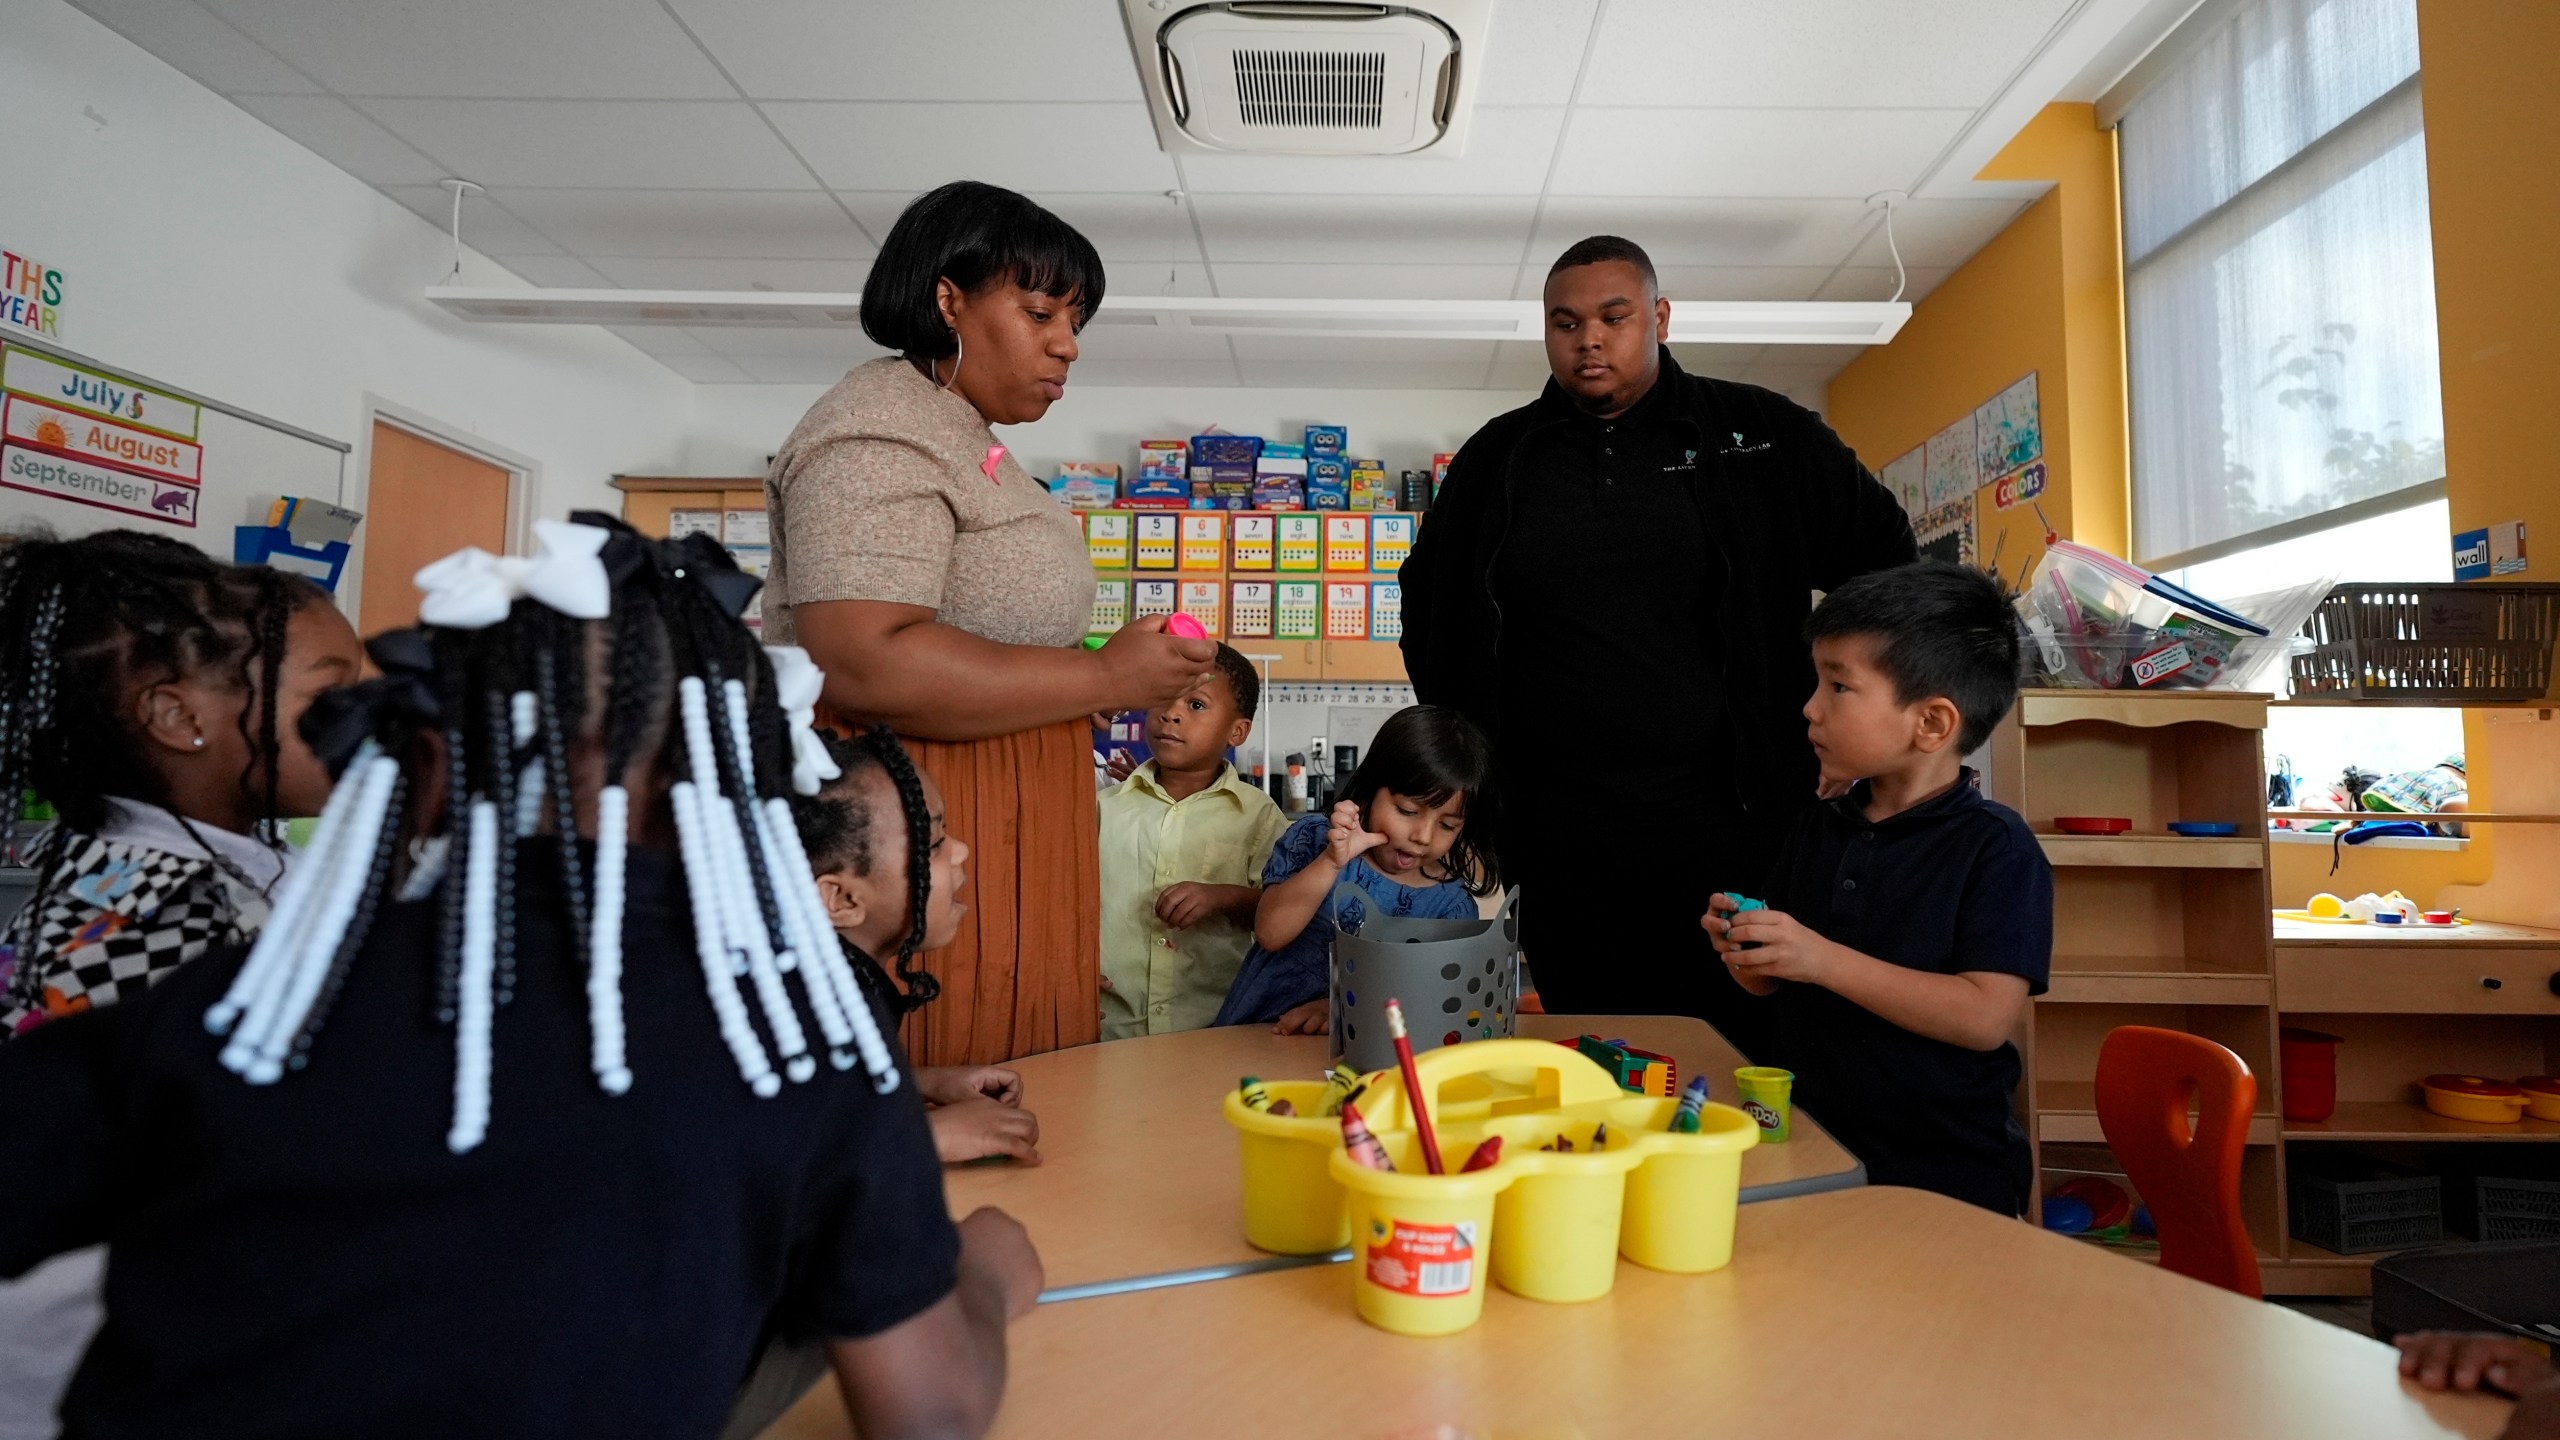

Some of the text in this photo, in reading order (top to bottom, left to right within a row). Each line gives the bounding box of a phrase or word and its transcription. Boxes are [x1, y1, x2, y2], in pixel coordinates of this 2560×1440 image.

[0, 291, 57, 337] YEAR
[62, 374, 124, 415] July
[86, 426, 179, 468] August
[10, 454, 146, 501] September
[2000, 471, 2040, 502] COLORS
[1105, 518, 1113, 529] 4
[1153, 518, 1161, 530] 5
[1198, 519, 1206, 531] 6
[1251, 520, 1258, 531] 7
[1295, 520, 1303, 532] 8
[1342, 521, 1350, 532] 9
[1384, 521, 1399, 532] 10
[2457, 543, 2485, 567] wall
[1099, 584, 1113, 595] 14
[1149, 584, 1163, 596] 15
[1193, 585, 1207, 597] 16
[1246, 586, 1259, 597] 17
[1290, 586, 1303, 598] 18
[1340, 587, 1352, 598] 19
[1384, 587, 1400, 599] 20
[1280, 694, 1291, 703] 24
[1296, 694, 1308, 703] 25
[1313, 694, 1325, 703] 26
[1331, 694, 1342, 703] 27
[1348, 694, 1359, 703] 28
[1365, 695, 1376, 704] 29
[1382, 695, 1393, 704] 30
[1400, 695, 1409, 704] 31
